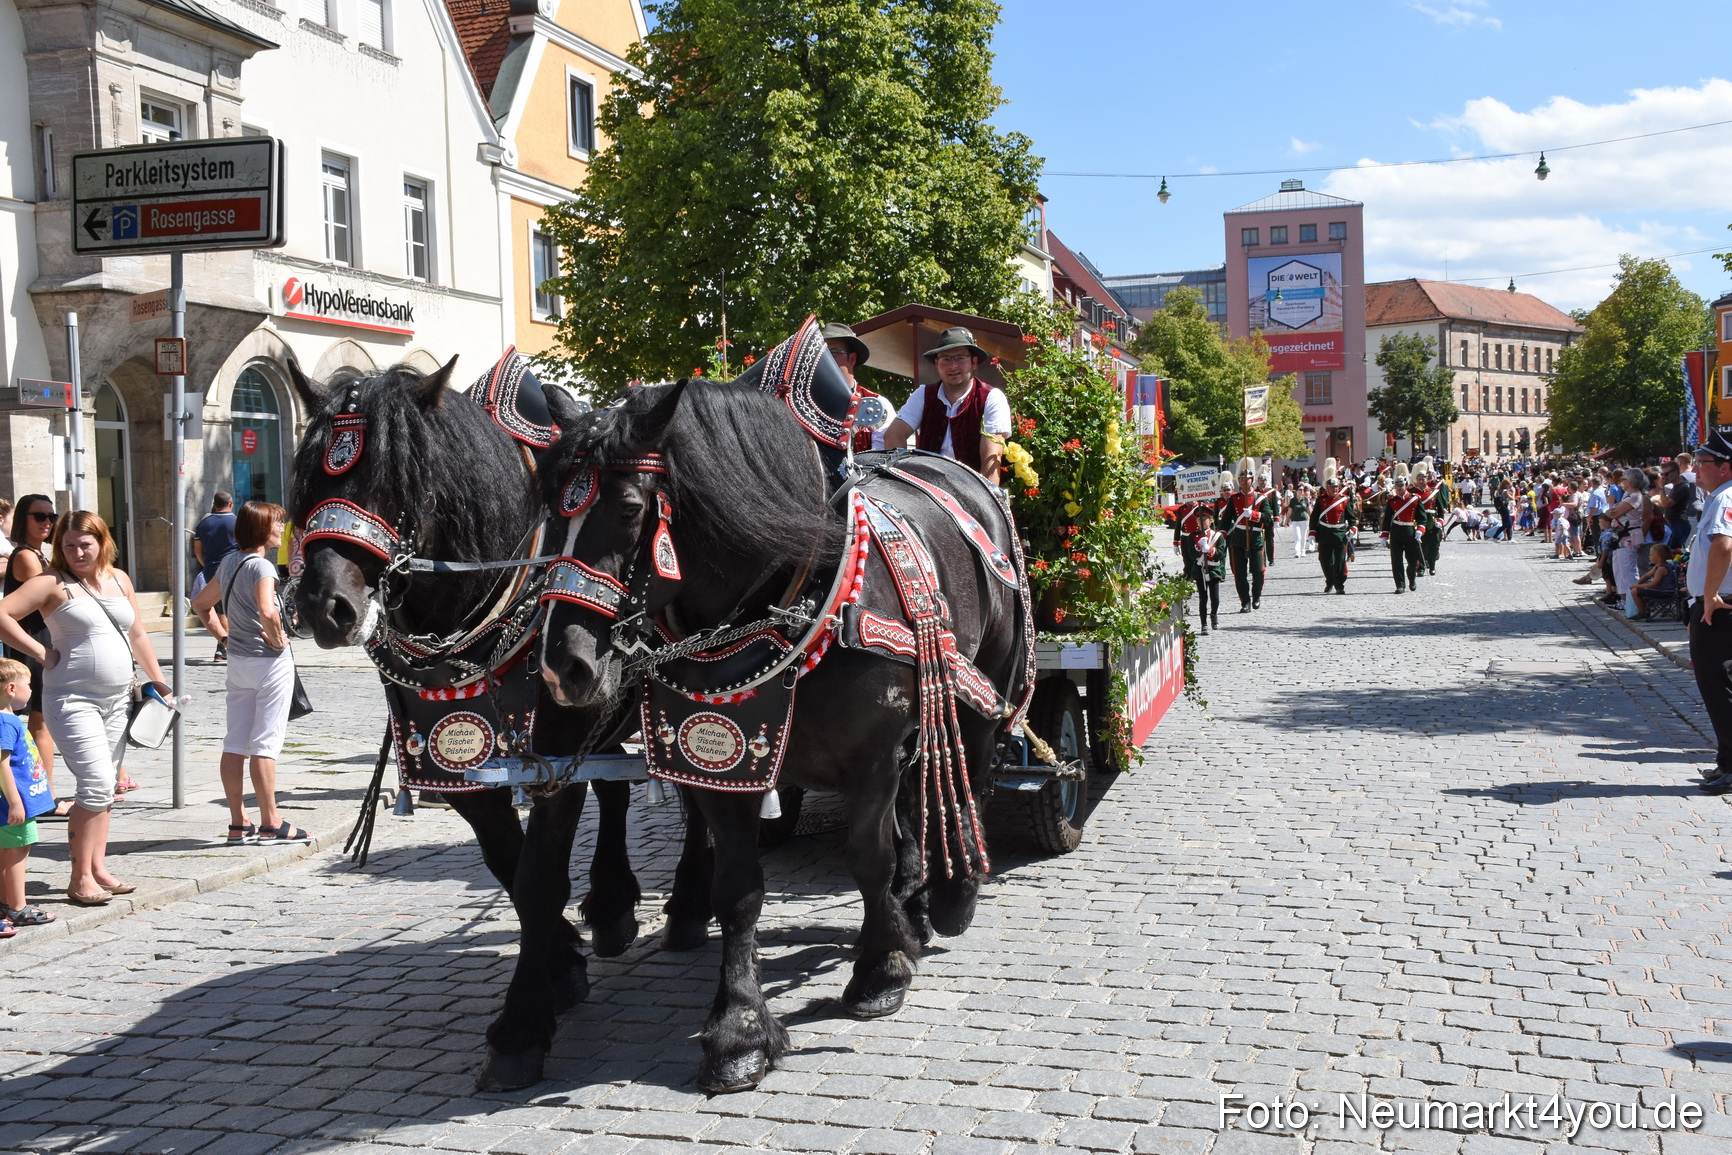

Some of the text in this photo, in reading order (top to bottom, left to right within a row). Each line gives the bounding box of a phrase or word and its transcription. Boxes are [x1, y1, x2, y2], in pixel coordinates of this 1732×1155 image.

[105, 157, 235, 189] Parkleitsystem
[150, 208, 236, 232] Rosengasse
[120, 217, 131, 237] P
[133, 298, 166, 317] Rosengass
[304, 282, 414, 322] HypoVereinsbank
[1264, 341, 1334, 354] usgezeichnet!
[445, 728, 476, 737] Michael
[696, 727, 728, 739] Michael
[697, 736, 725, 747] Fischer
[444, 747, 476, 755] Pilsheim
[695, 745, 728, 757] Pilsheim
